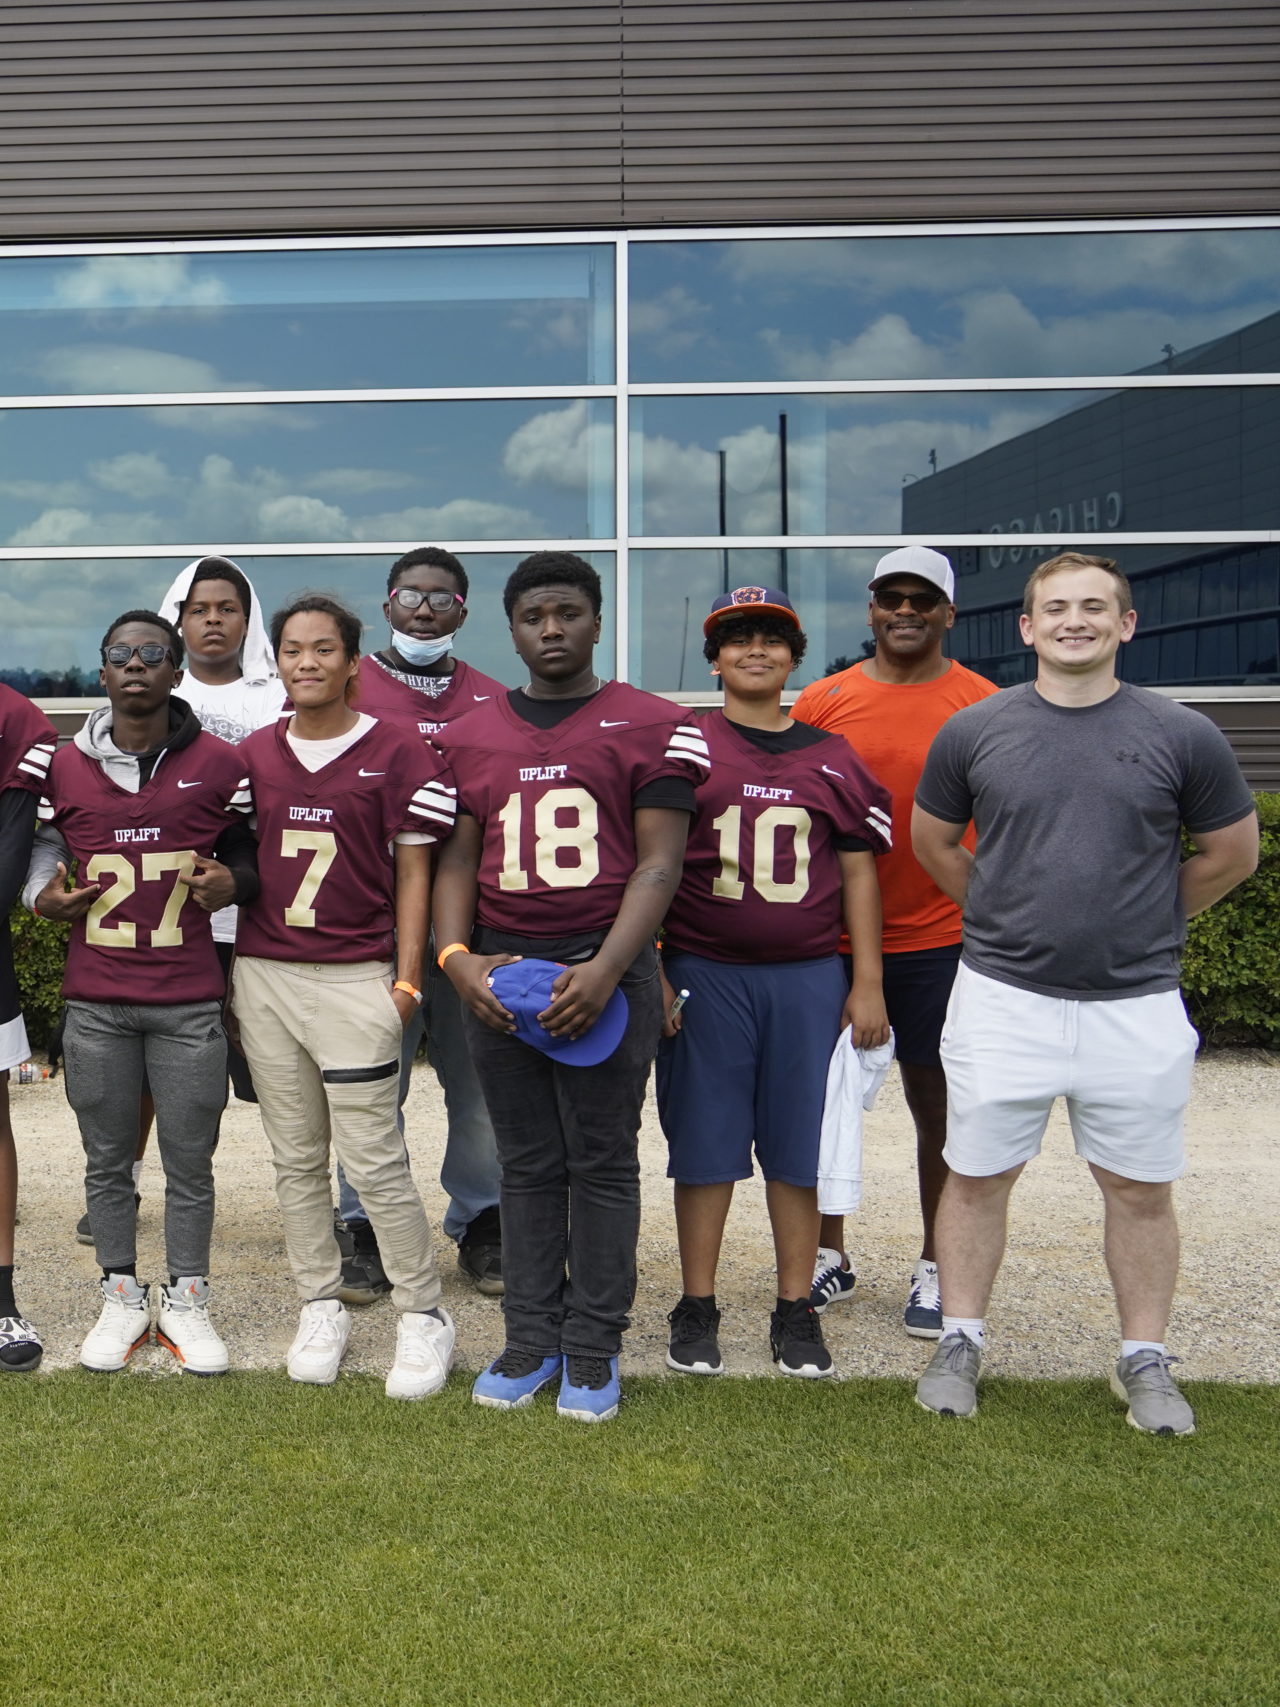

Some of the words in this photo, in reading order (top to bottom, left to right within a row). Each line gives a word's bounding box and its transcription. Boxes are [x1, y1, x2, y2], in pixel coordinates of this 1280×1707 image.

[407, 674, 437, 688] HYPE
[519, 764, 567, 781] UPLIFT
[743, 783, 792, 800] UPLIFT
[288, 806, 333, 822] UPLIFT
[114, 827, 160, 842] UPLIFT
[498, 787, 600, 890] 18
[712, 805, 812, 903] 10
[280, 829, 338, 927] 7
[86, 850, 196, 949] 27
